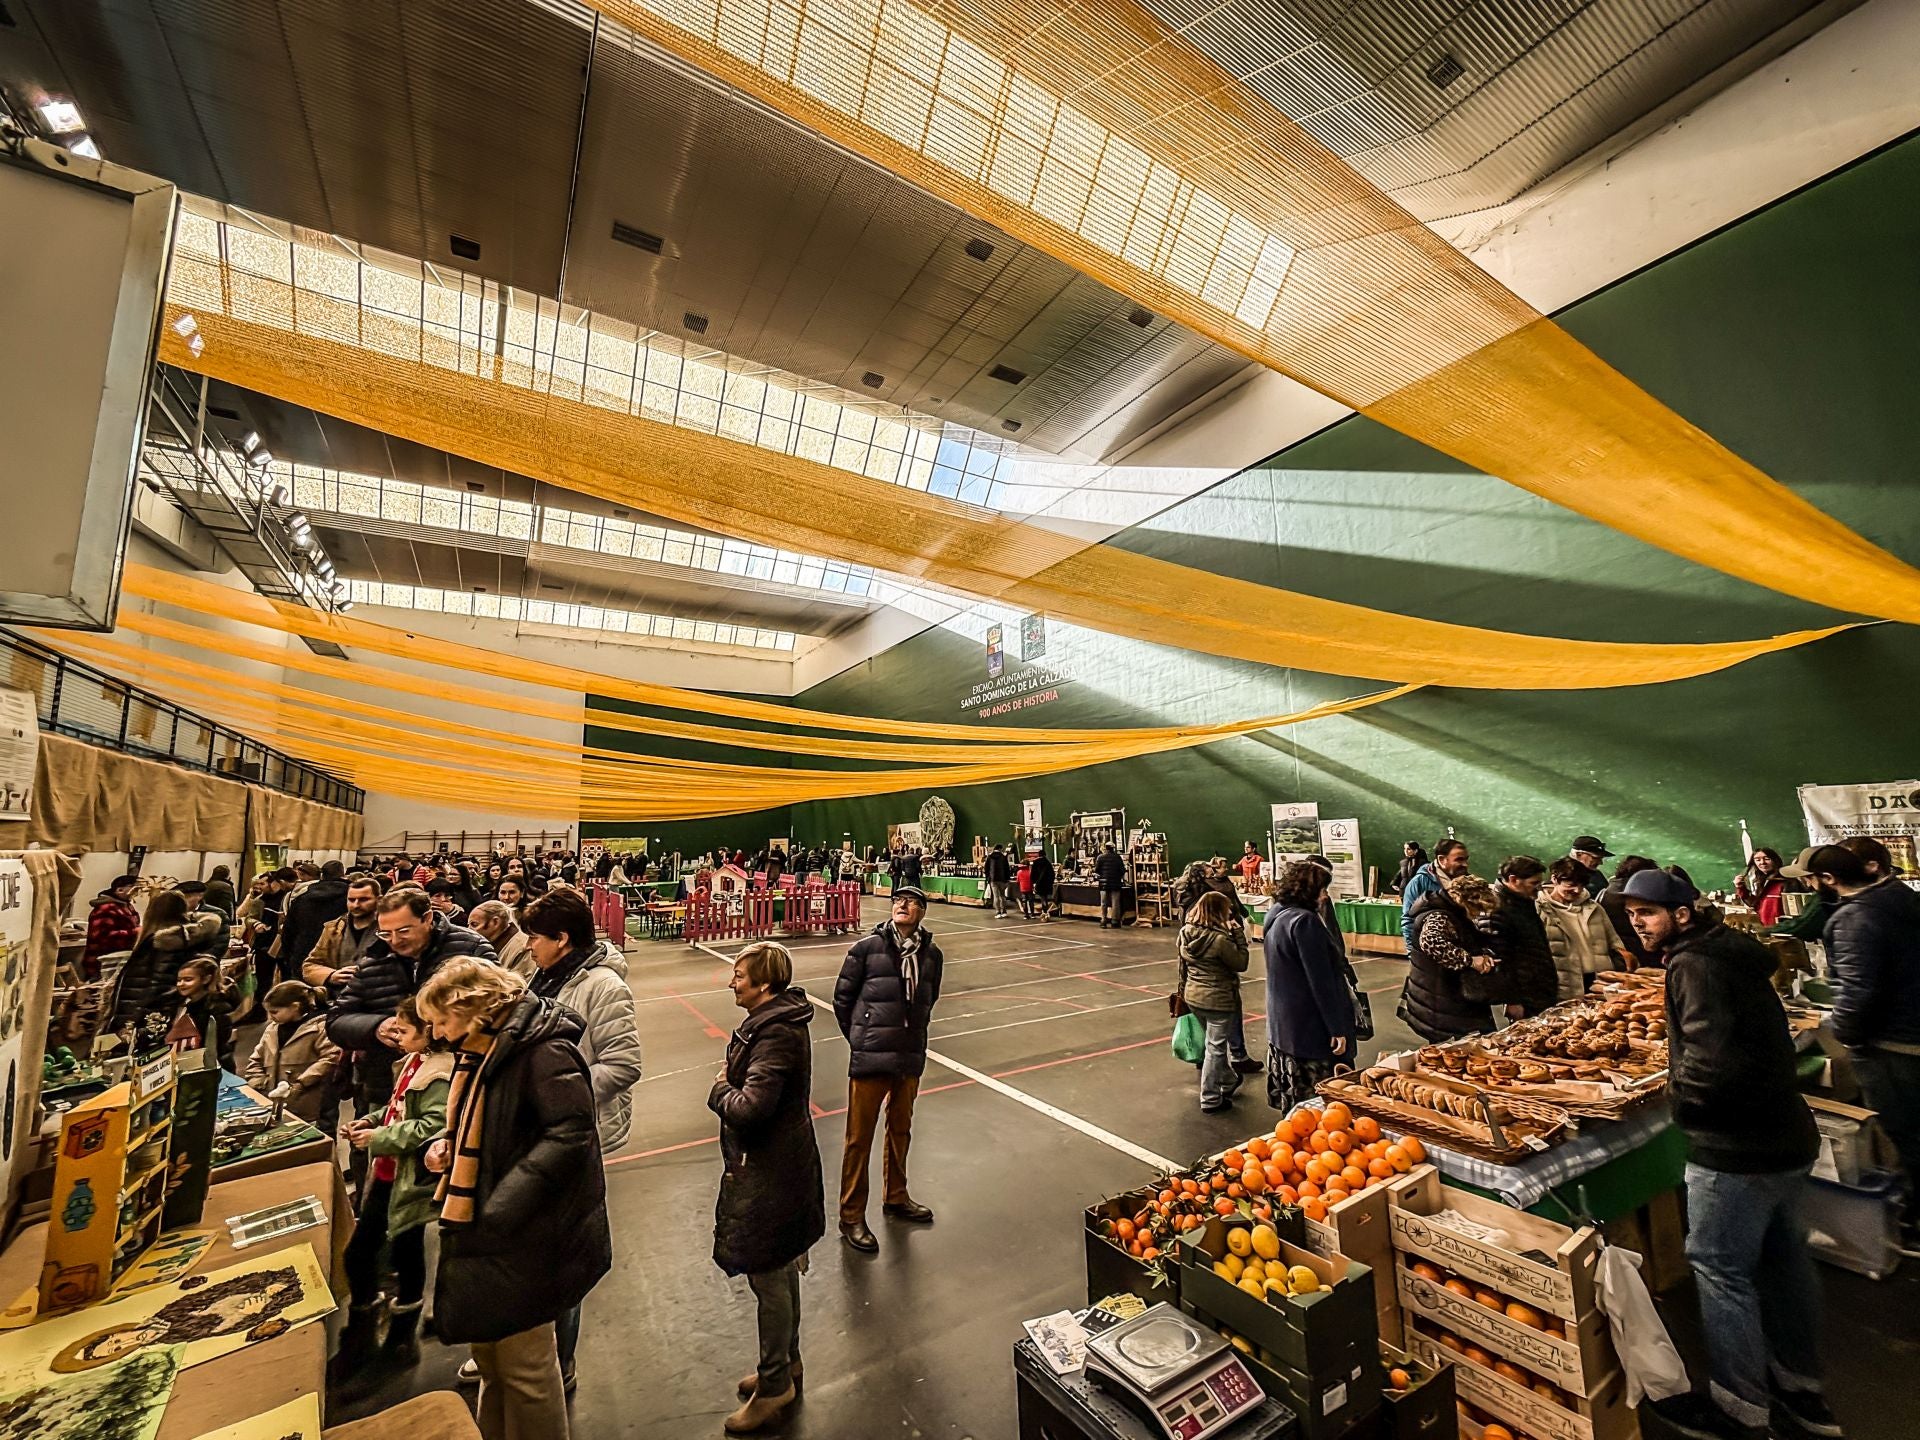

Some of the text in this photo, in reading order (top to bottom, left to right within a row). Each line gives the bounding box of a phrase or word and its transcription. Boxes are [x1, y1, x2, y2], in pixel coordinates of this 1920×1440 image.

[960, 668, 1078, 709] SANTO DOMINGO DE LA CALZADA
[973, 682, 994, 695] EXCMO.
[996, 665, 1047, 687] AYUNTAMIENTO
[978, 709, 991, 719] 900
[1012, 700, 1022, 710] DE
[1023, 689, 1059, 708] HISTORIA
